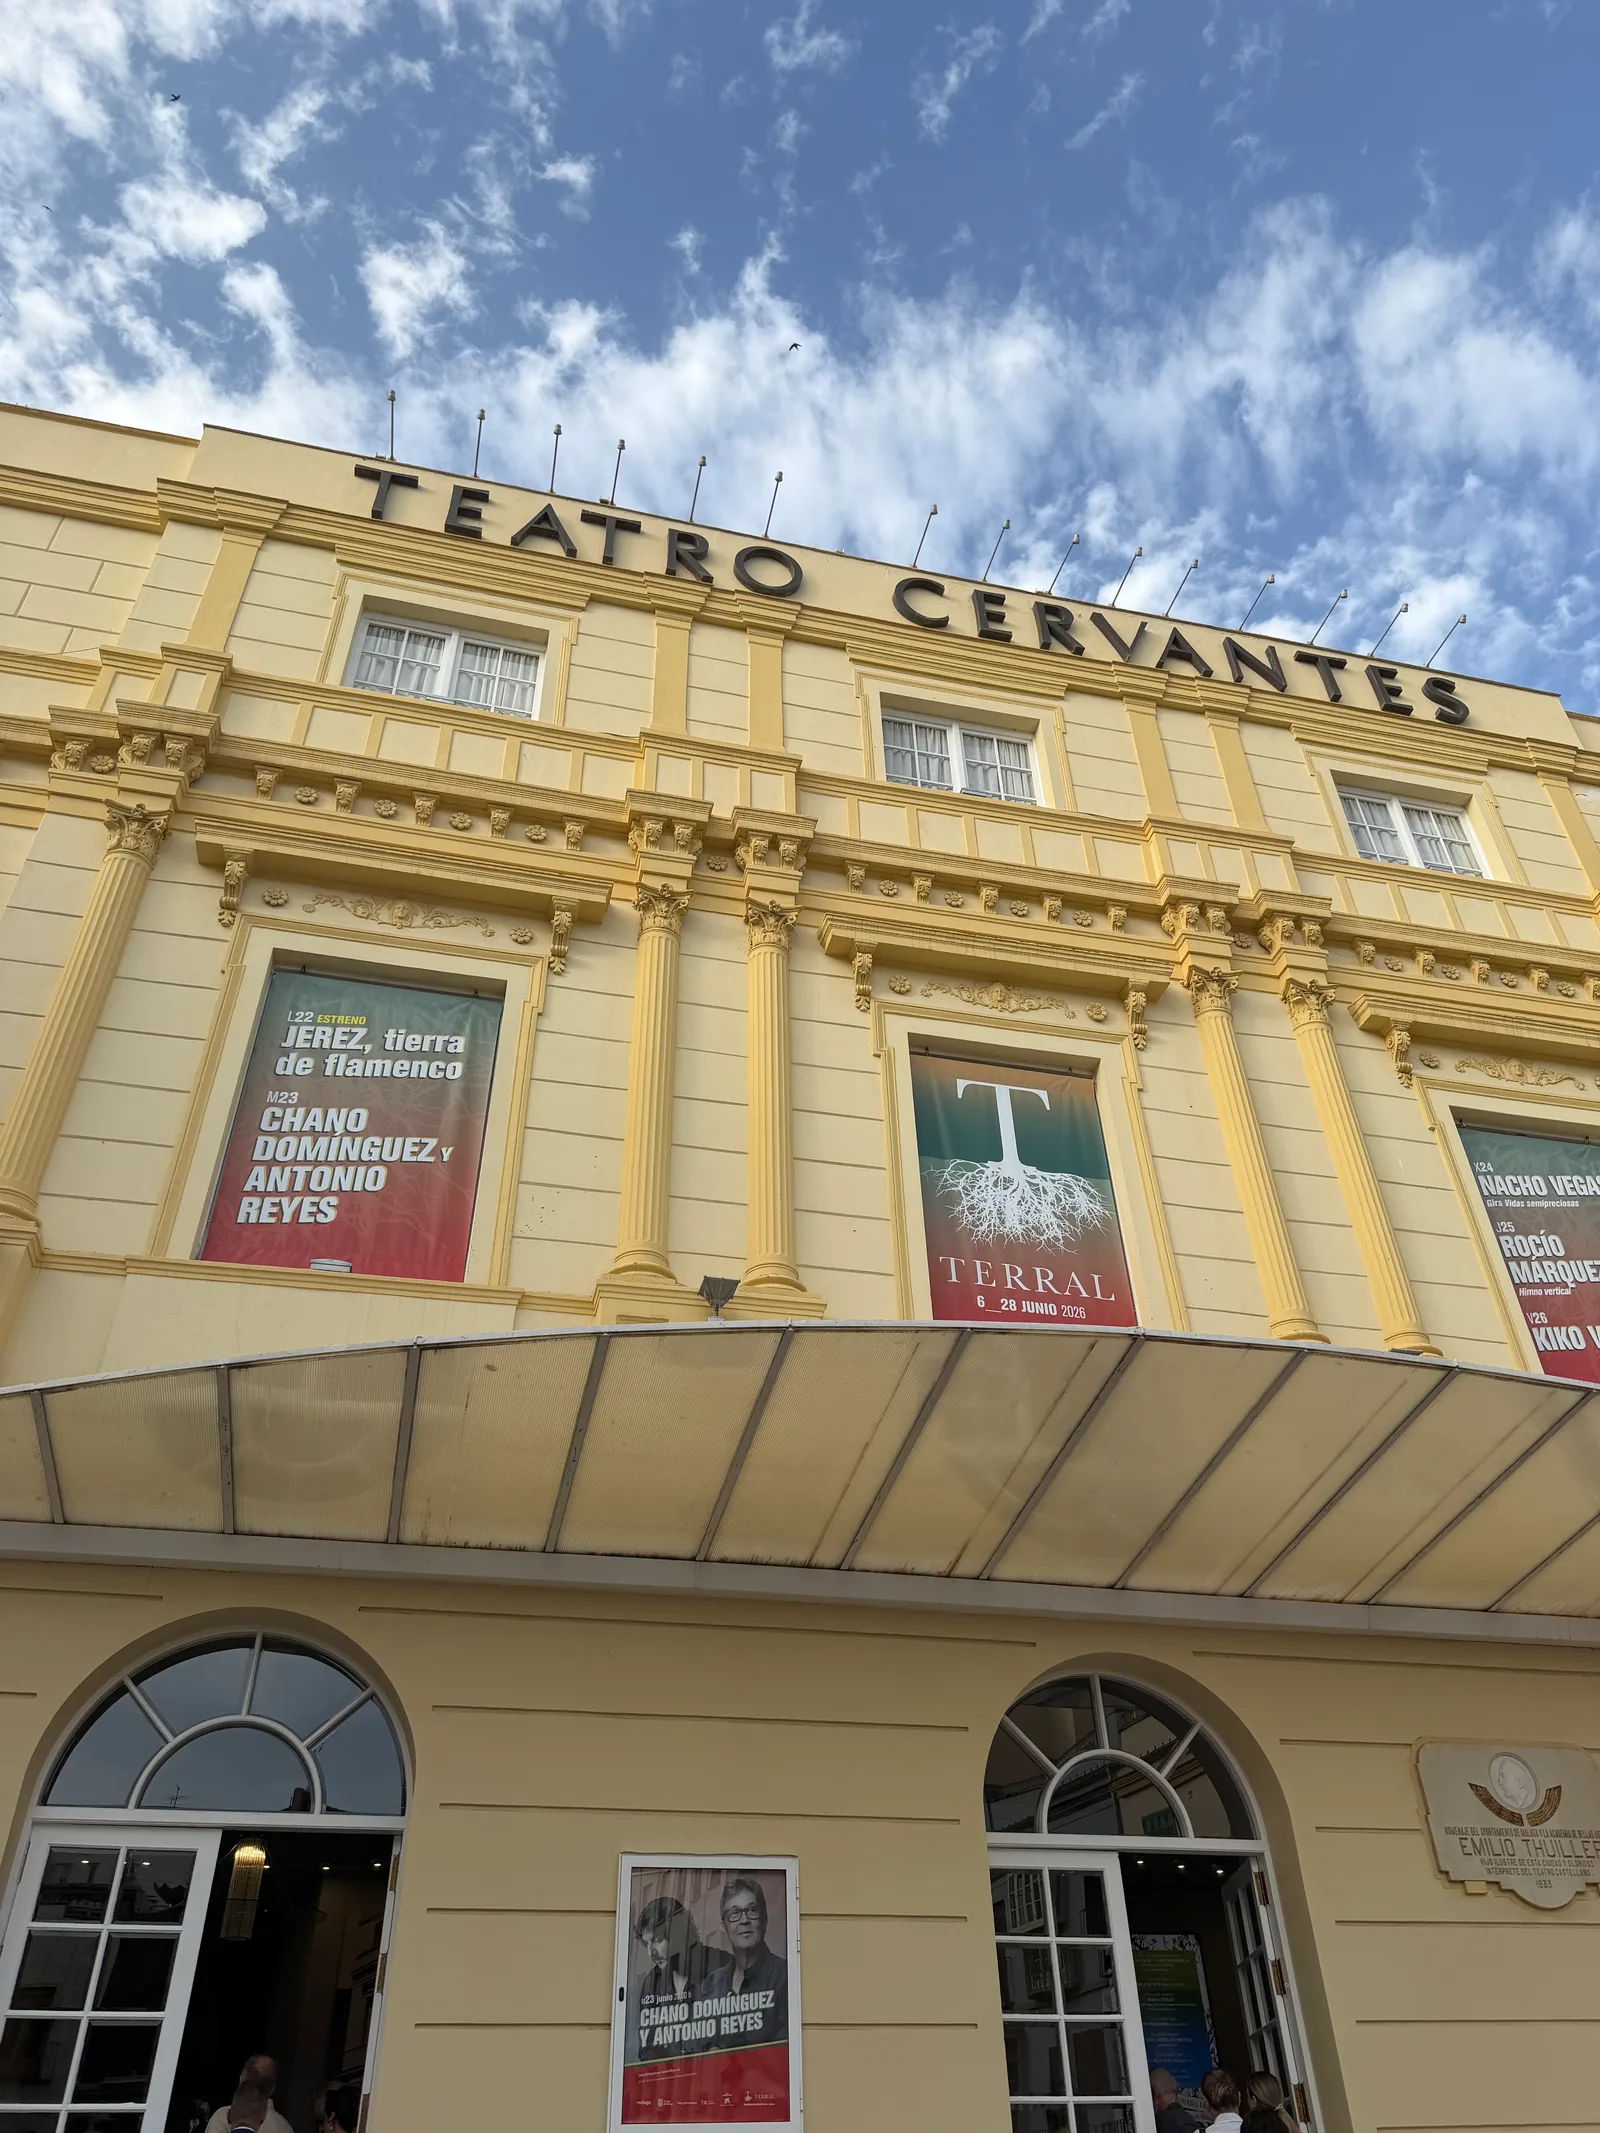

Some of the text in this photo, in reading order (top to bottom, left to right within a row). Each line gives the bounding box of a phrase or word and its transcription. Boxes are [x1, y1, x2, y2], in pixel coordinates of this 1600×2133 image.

[354, 464, 1469, 725] TEATRO CERVANTES
[287, 1010, 366, 1025] L22 ESTRENO
[281, 1025, 466, 1055] JEREZ, tierra
[275, 1053, 463, 1080] de flamenco
[266, 1091, 299, 1104] M23
[259, 1107, 369, 1132] CHANO
[252, 1130, 455, 1163] DOMÍNGUEZ Y
[242, 1165, 387, 1193] ANTONIO
[1473, 1161, 1494, 1173] X24
[1477, 1174, 1549, 1197] NACHO
[236, 1196, 340, 1225] REYES
[1486, 1199, 1580, 1209] Gira Vidas semipreciosas
[1496, 1221, 1516, 1233] J25
[1498, 1229, 1566, 1258] ROCÍO
[939, 1256, 1115, 1301] TERRAL
[1519, 1286, 1572, 1297] Himno vertical
[1021, 1300, 1057, 1316] JUNIO
[1061, 1304, 1086, 1319] 2026
[1526, 1312, 1548, 1324] V26
[1531, 1325, 1587, 1352] KIKO
[1459, 1837, 1516, 1857] EMILIO
[1533, 1868, 1555, 1876] TEATRO
[640, 1989, 775, 2027] CHANO DOMÍNGUEZ
[656, 1993, 673, 2005] junio
[639, 2011, 763, 2048] Y ANTONIO REYES
